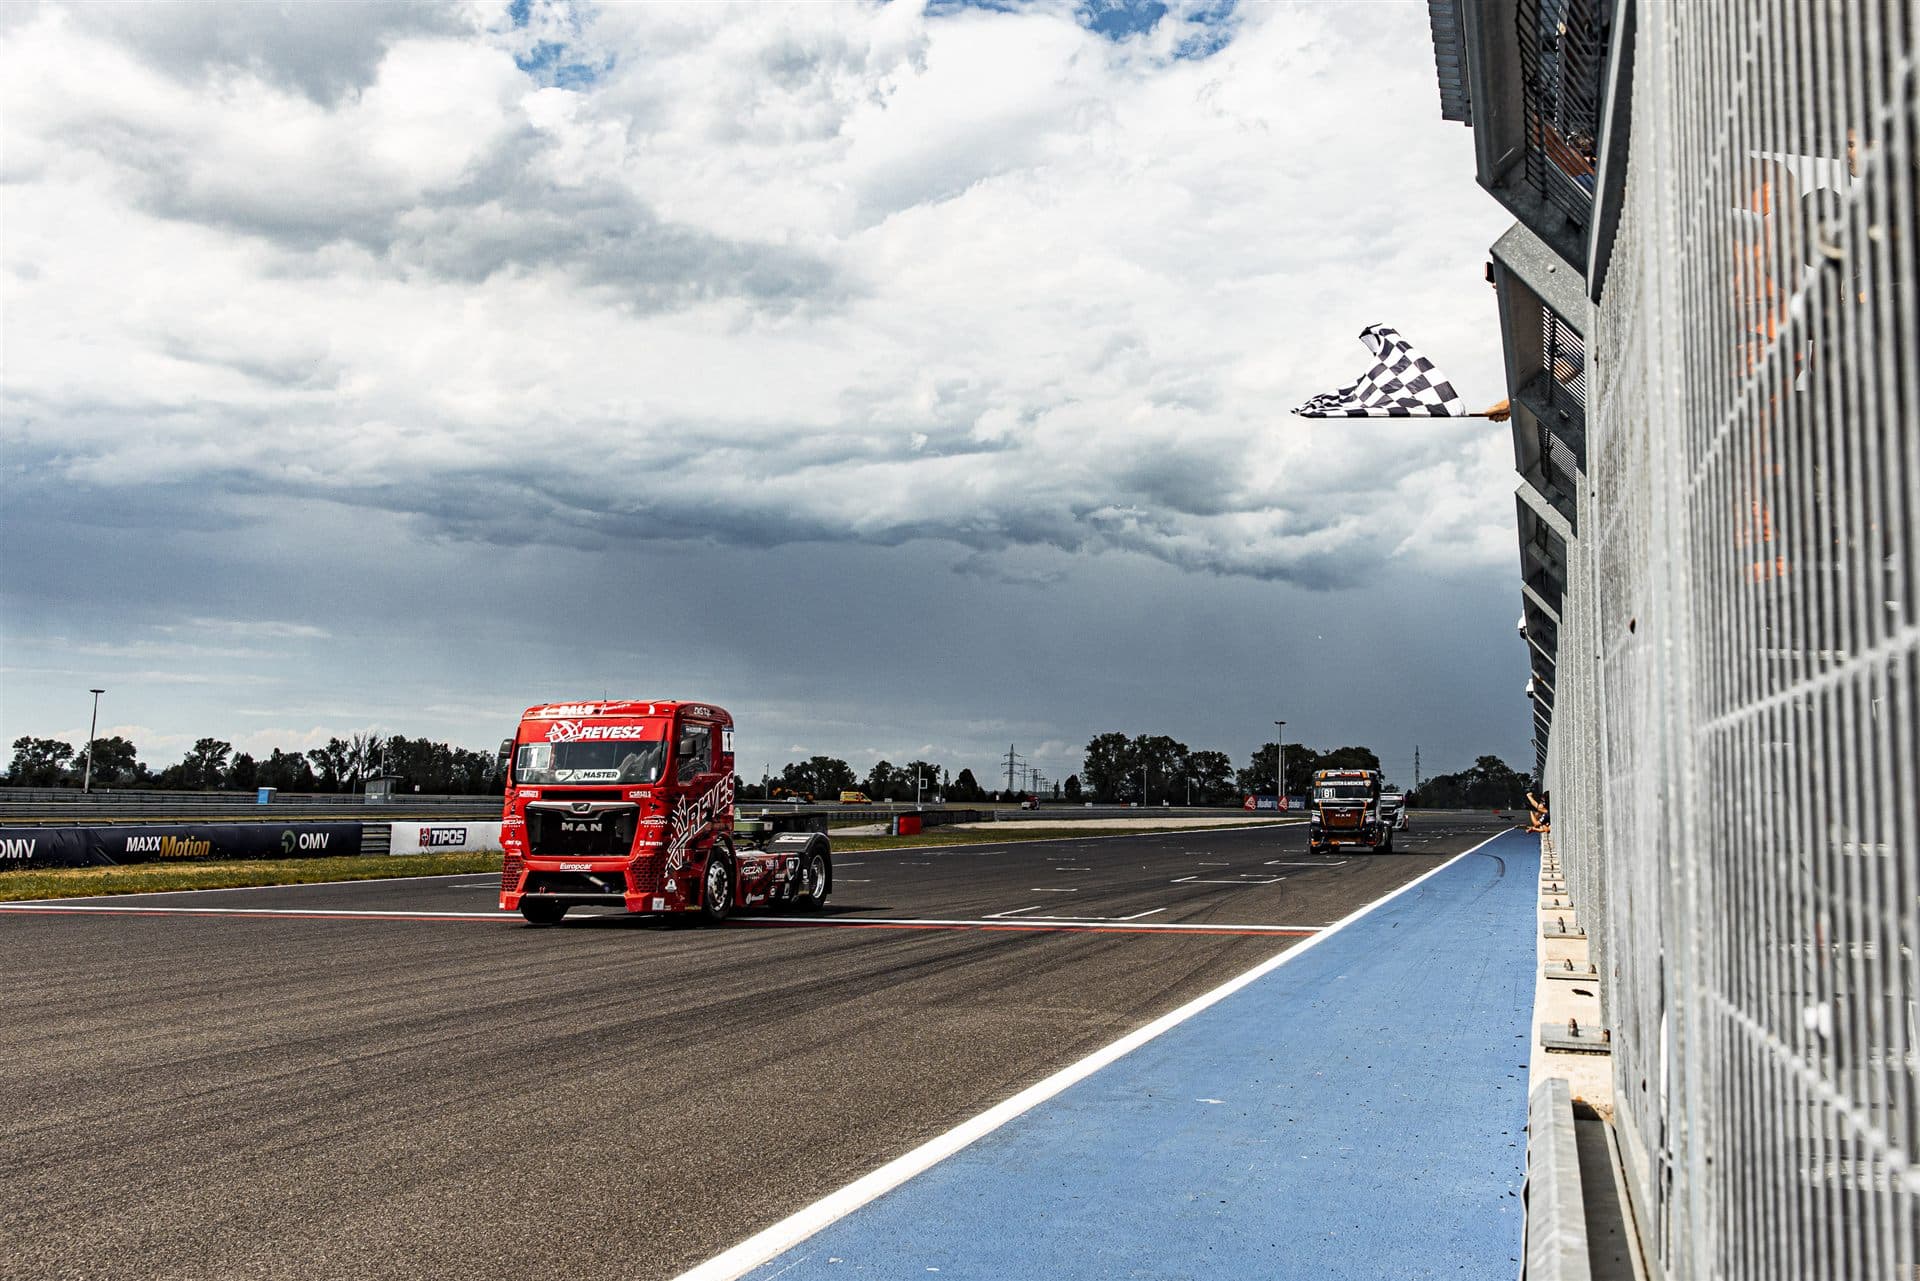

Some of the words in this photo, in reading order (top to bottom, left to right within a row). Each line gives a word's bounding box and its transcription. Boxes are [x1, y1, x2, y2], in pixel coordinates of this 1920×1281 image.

[580, 726, 643, 738] REVESZ
[530, 748, 538, 768] 1
[583, 771, 618, 779] MASTER
[561, 822, 603, 832] MAN
[299, 833, 330, 850] OMV
[431, 829, 465, 845] TIPOS
[560, 862, 592, 872] Europcar
